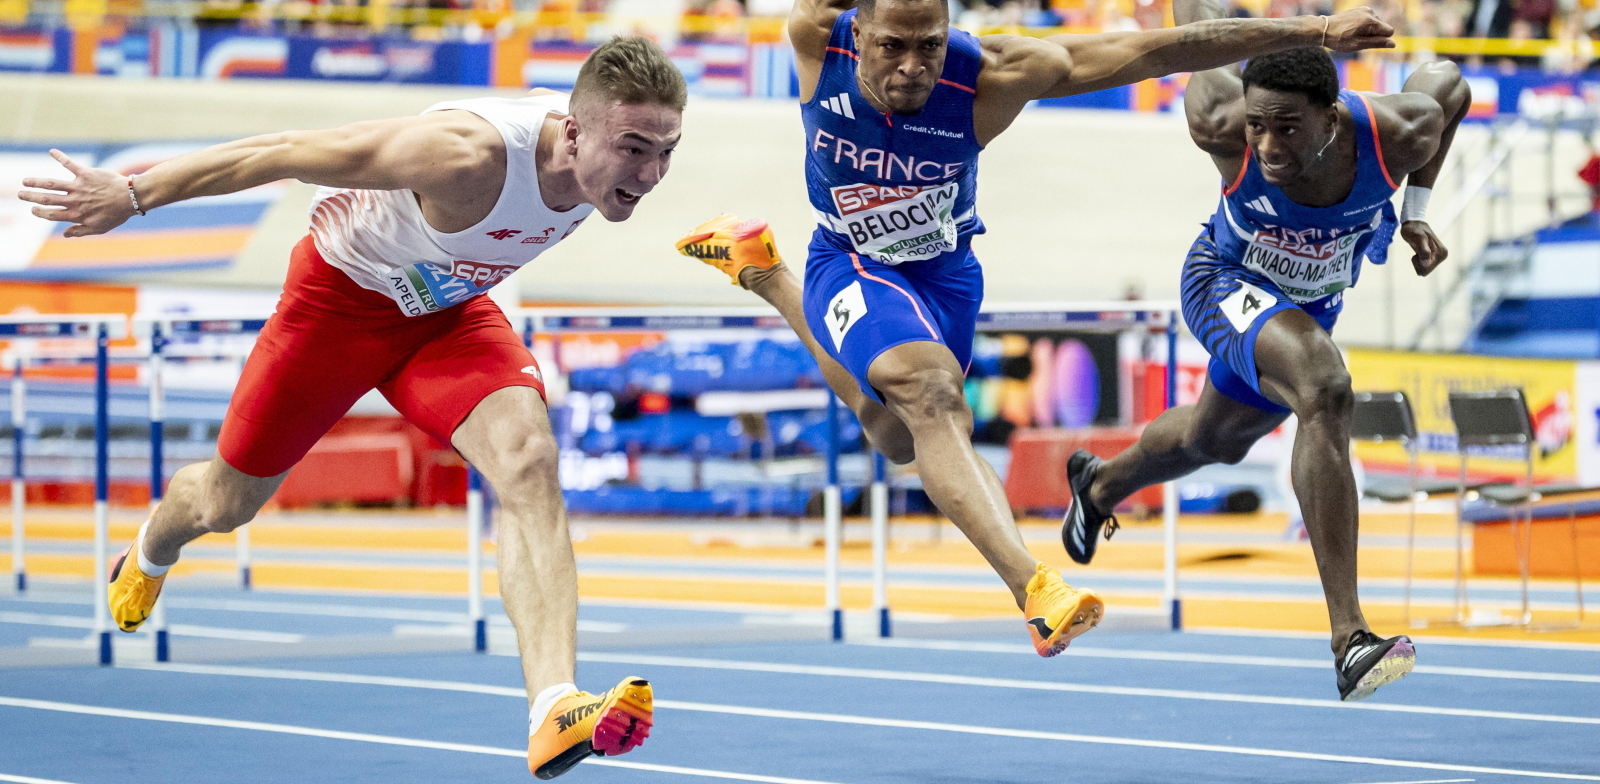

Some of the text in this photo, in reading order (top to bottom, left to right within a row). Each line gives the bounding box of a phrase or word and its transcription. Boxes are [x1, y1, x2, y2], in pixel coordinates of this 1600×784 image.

[903, 124, 964, 139] Crédit Mutuel
[813, 128, 964, 181] FRANCE
[486, 228, 523, 241] 4F
[833, 297, 851, 333] 5
[1242, 291, 1262, 316] 4
[554, 696, 607, 735] NITRO
